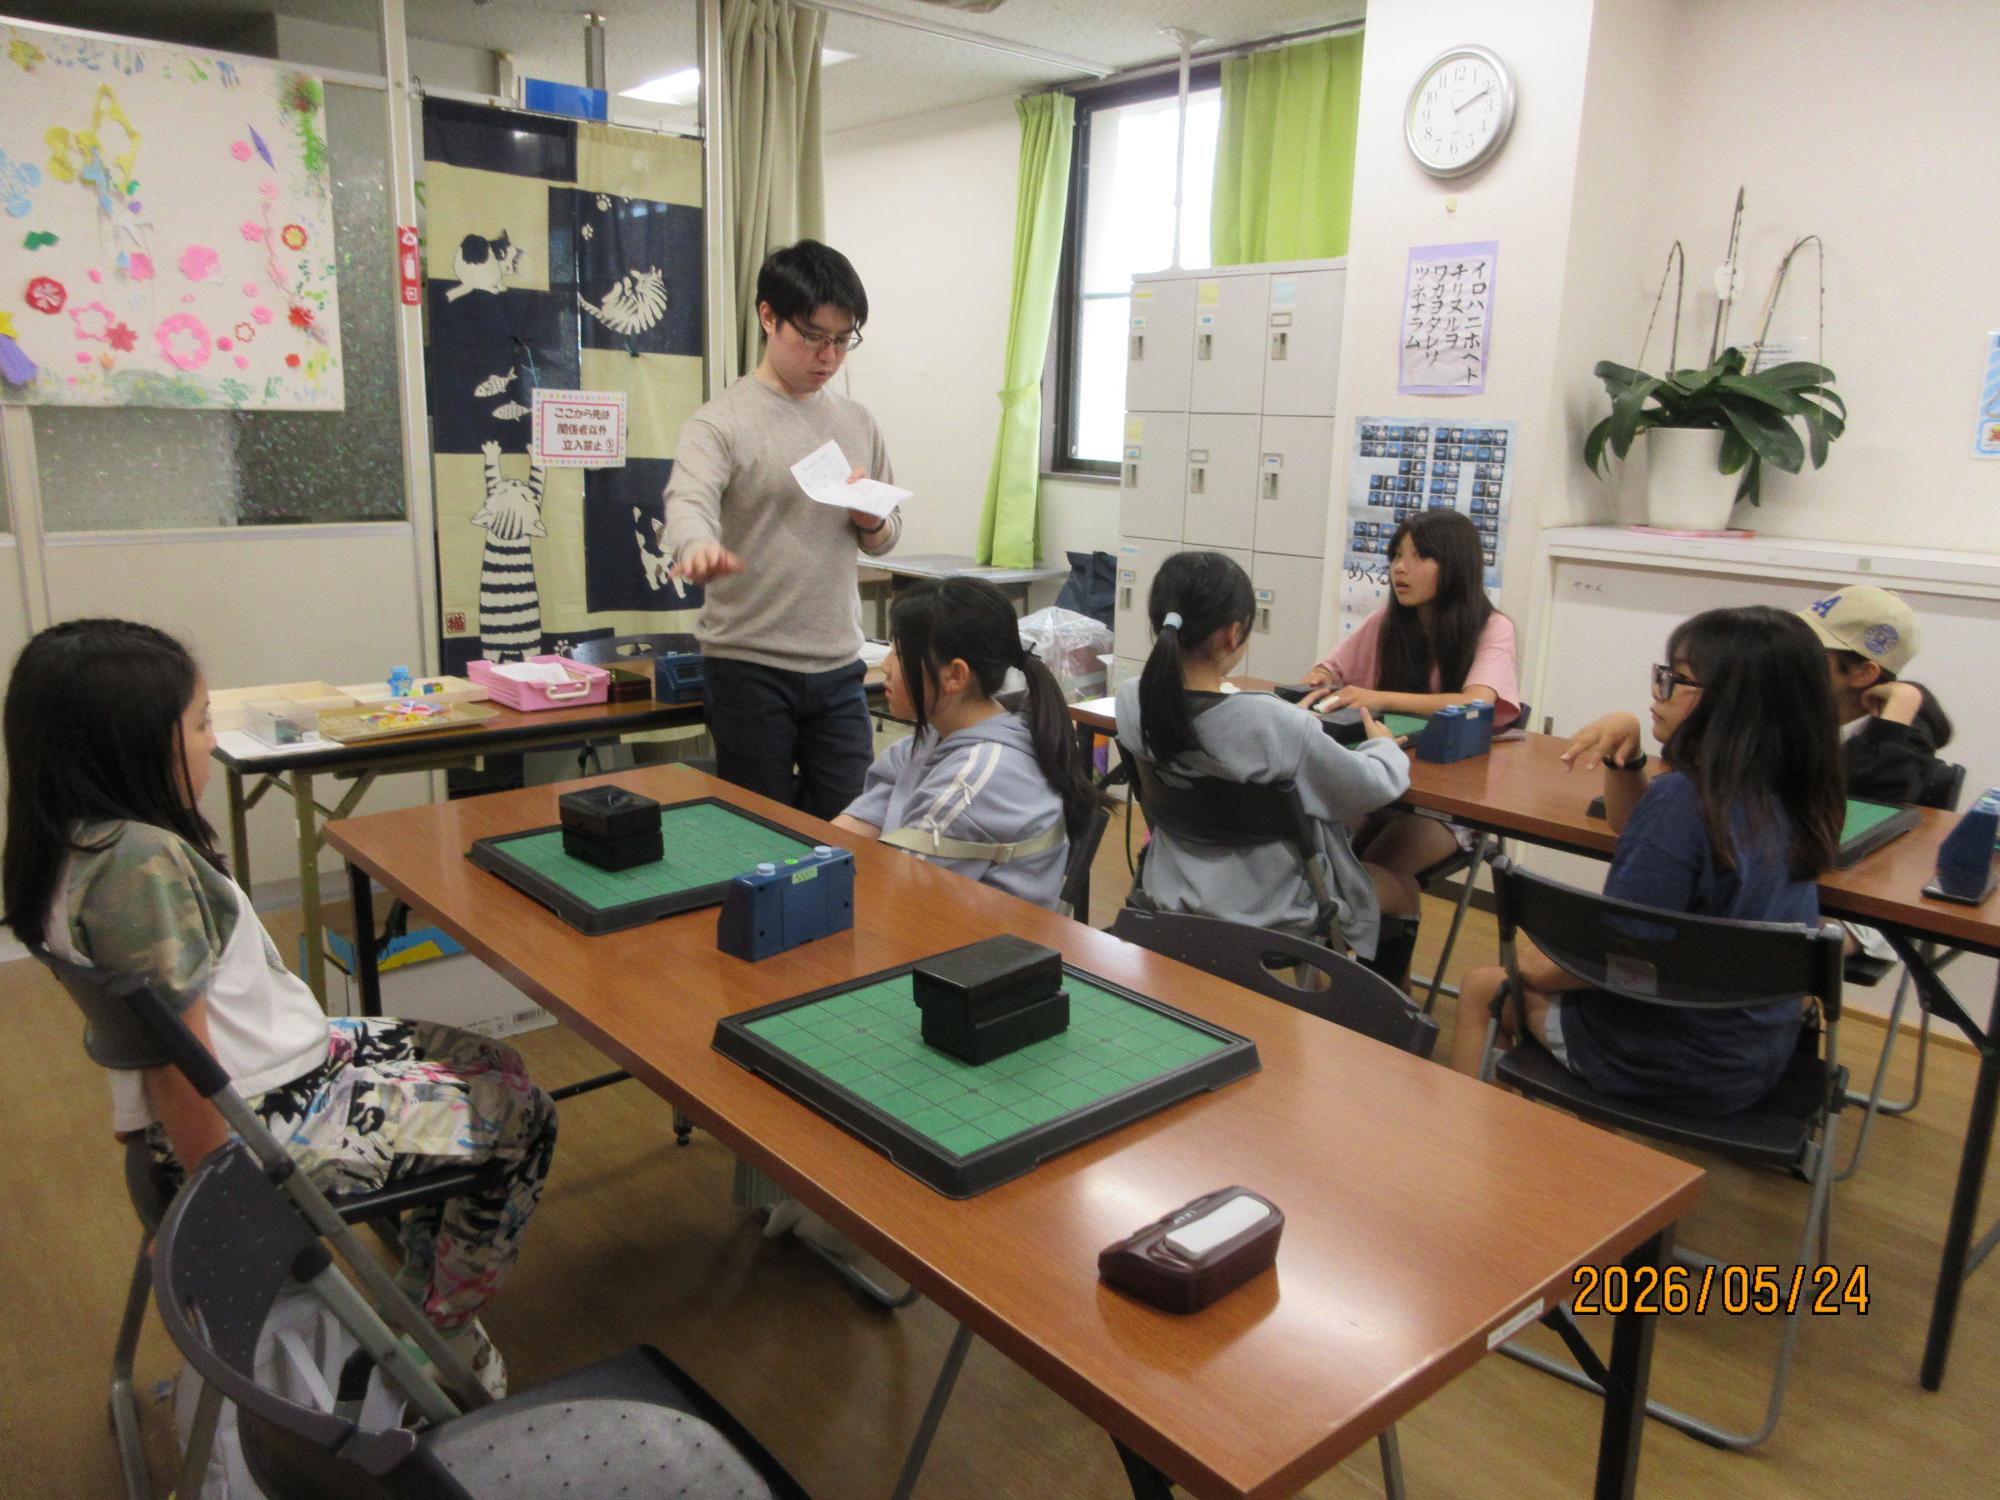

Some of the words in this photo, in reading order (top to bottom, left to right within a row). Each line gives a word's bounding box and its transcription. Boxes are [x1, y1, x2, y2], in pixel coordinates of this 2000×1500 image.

[1454, 65, 1466, 81] 12
[1439, 74, 1447, 89] 11
[1425, 90, 1438, 105] 10
[1485, 97, 1493, 113] 3
[1422, 108, 1431, 122] 9
[1424, 126, 1433, 141] 8
[1465, 133, 1475, 149] 5
[1435, 138, 1443, 154] 7
[1450, 140, 1458, 155] 6
[1405, 266, 1429, 349] ツネナラム
[1445, 263, 1468, 349] チリヌルヲ
[1426, 265, 1448, 367] ワカヨタレソ
[1463, 262, 1487, 383] イロハニホヘト
[554, 408, 610, 420] ここから先は
[557, 424, 607, 435] 関係者以外
[563, 440, 601, 450] 立入禁止
[1812, 595, 1842, 618] A
